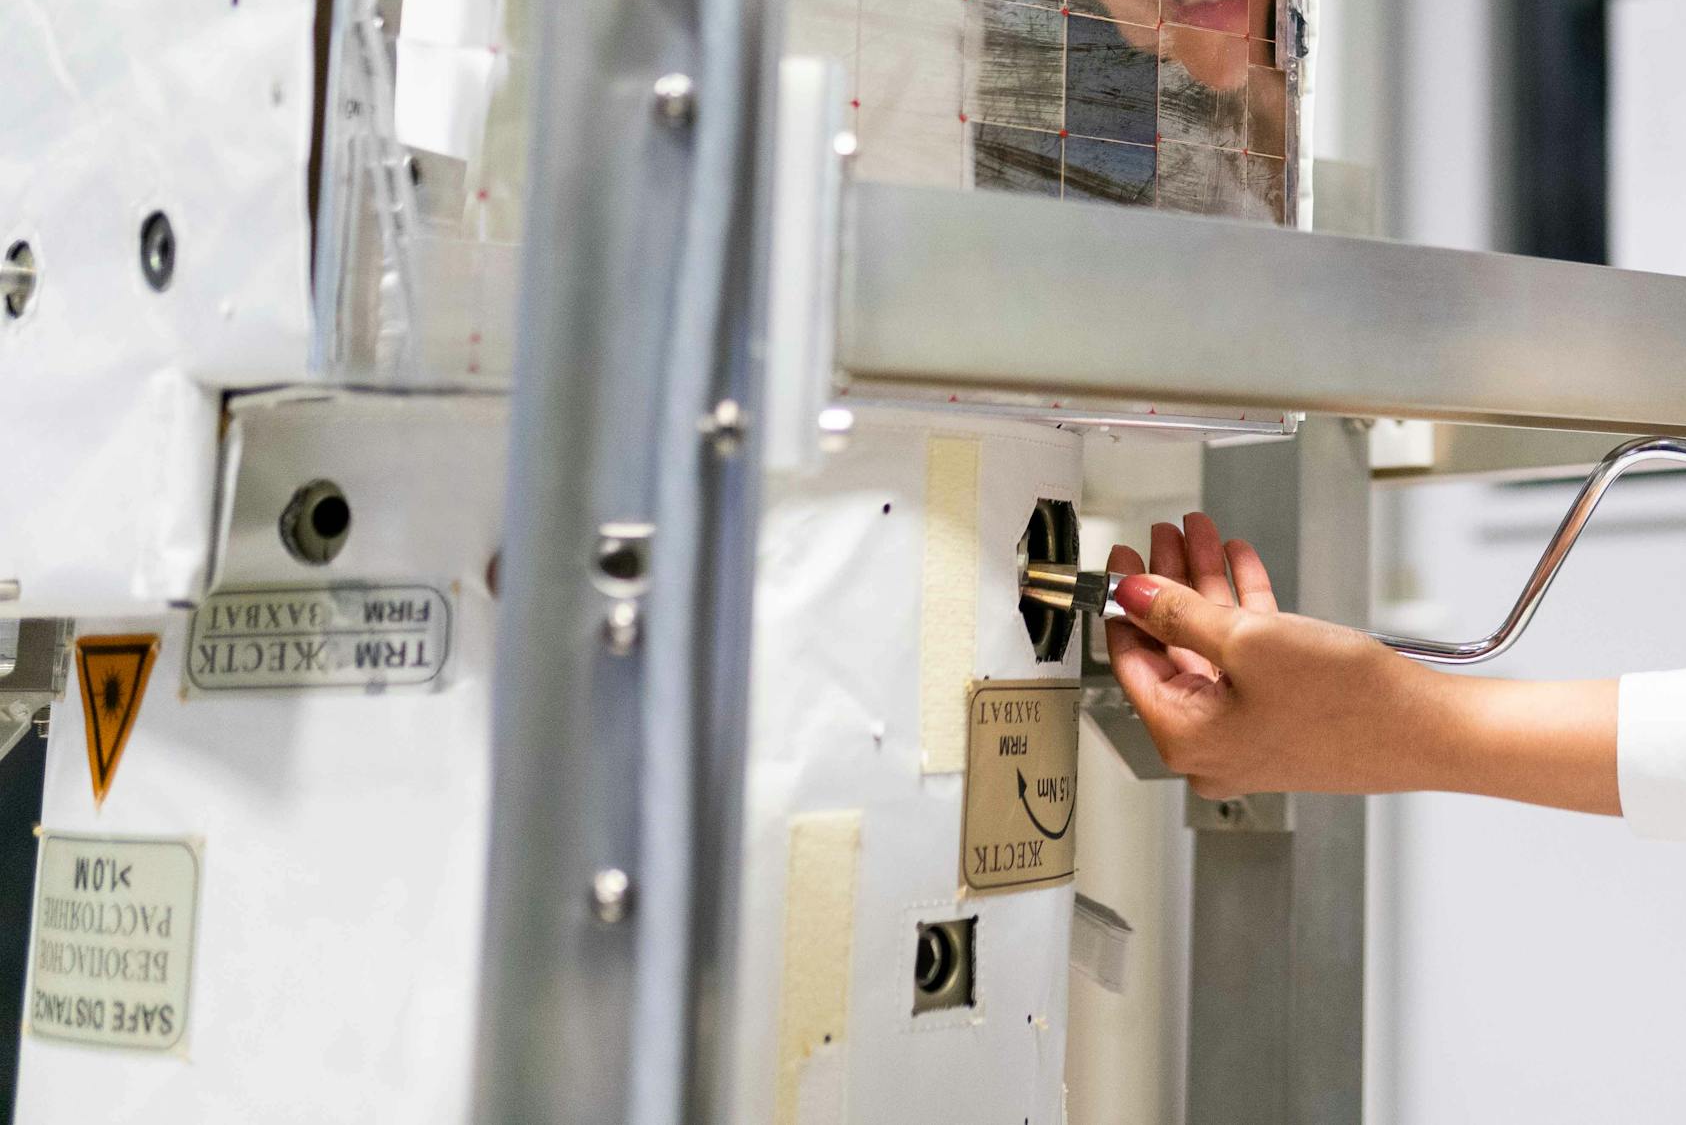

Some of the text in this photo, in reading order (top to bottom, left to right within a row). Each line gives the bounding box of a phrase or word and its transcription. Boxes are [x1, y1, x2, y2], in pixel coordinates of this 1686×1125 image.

[206, 603, 322, 631] ЗАХВАТ
[364, 599, 431, 624] FIRM
[197, 641, 326, 674] ЖЕСТК
[355, 640, 430, 670] TRM
[977, 701, 1041, 724] ЗАХВАТ
[999, 735, 1028, 756] FIRM
[1037, 778, 1058, 803] Nm
[974, 840, 1044, 875] ЖЕСТК
[34, 988, 174, 1036] SAFE DISTANCE
